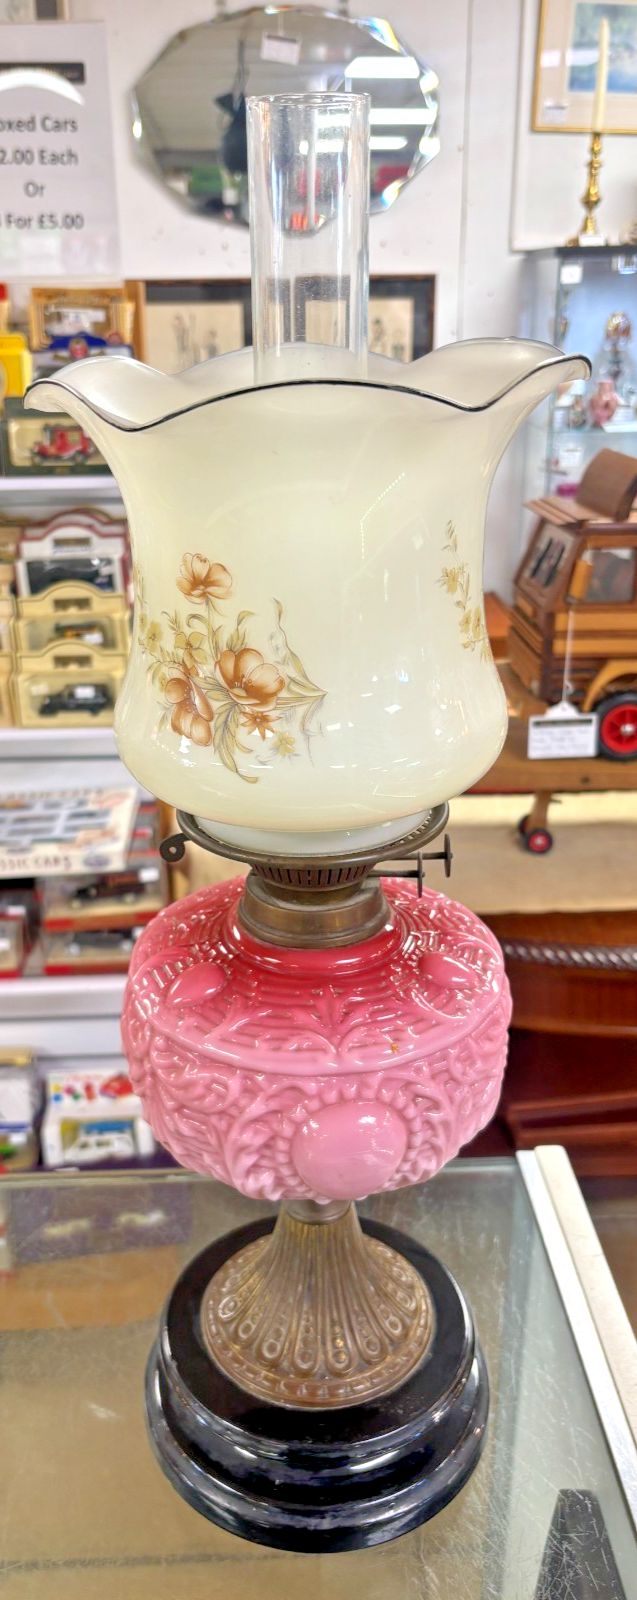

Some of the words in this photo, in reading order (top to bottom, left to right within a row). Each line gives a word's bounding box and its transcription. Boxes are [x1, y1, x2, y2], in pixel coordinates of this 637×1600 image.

[41, 116, 78, 132] Cars
[39, 148, 79, 165] Each
[24, 181, 45, 197] Or
[6, 213, 32, 229] For
[38, 213, 84, 230] £5.00
